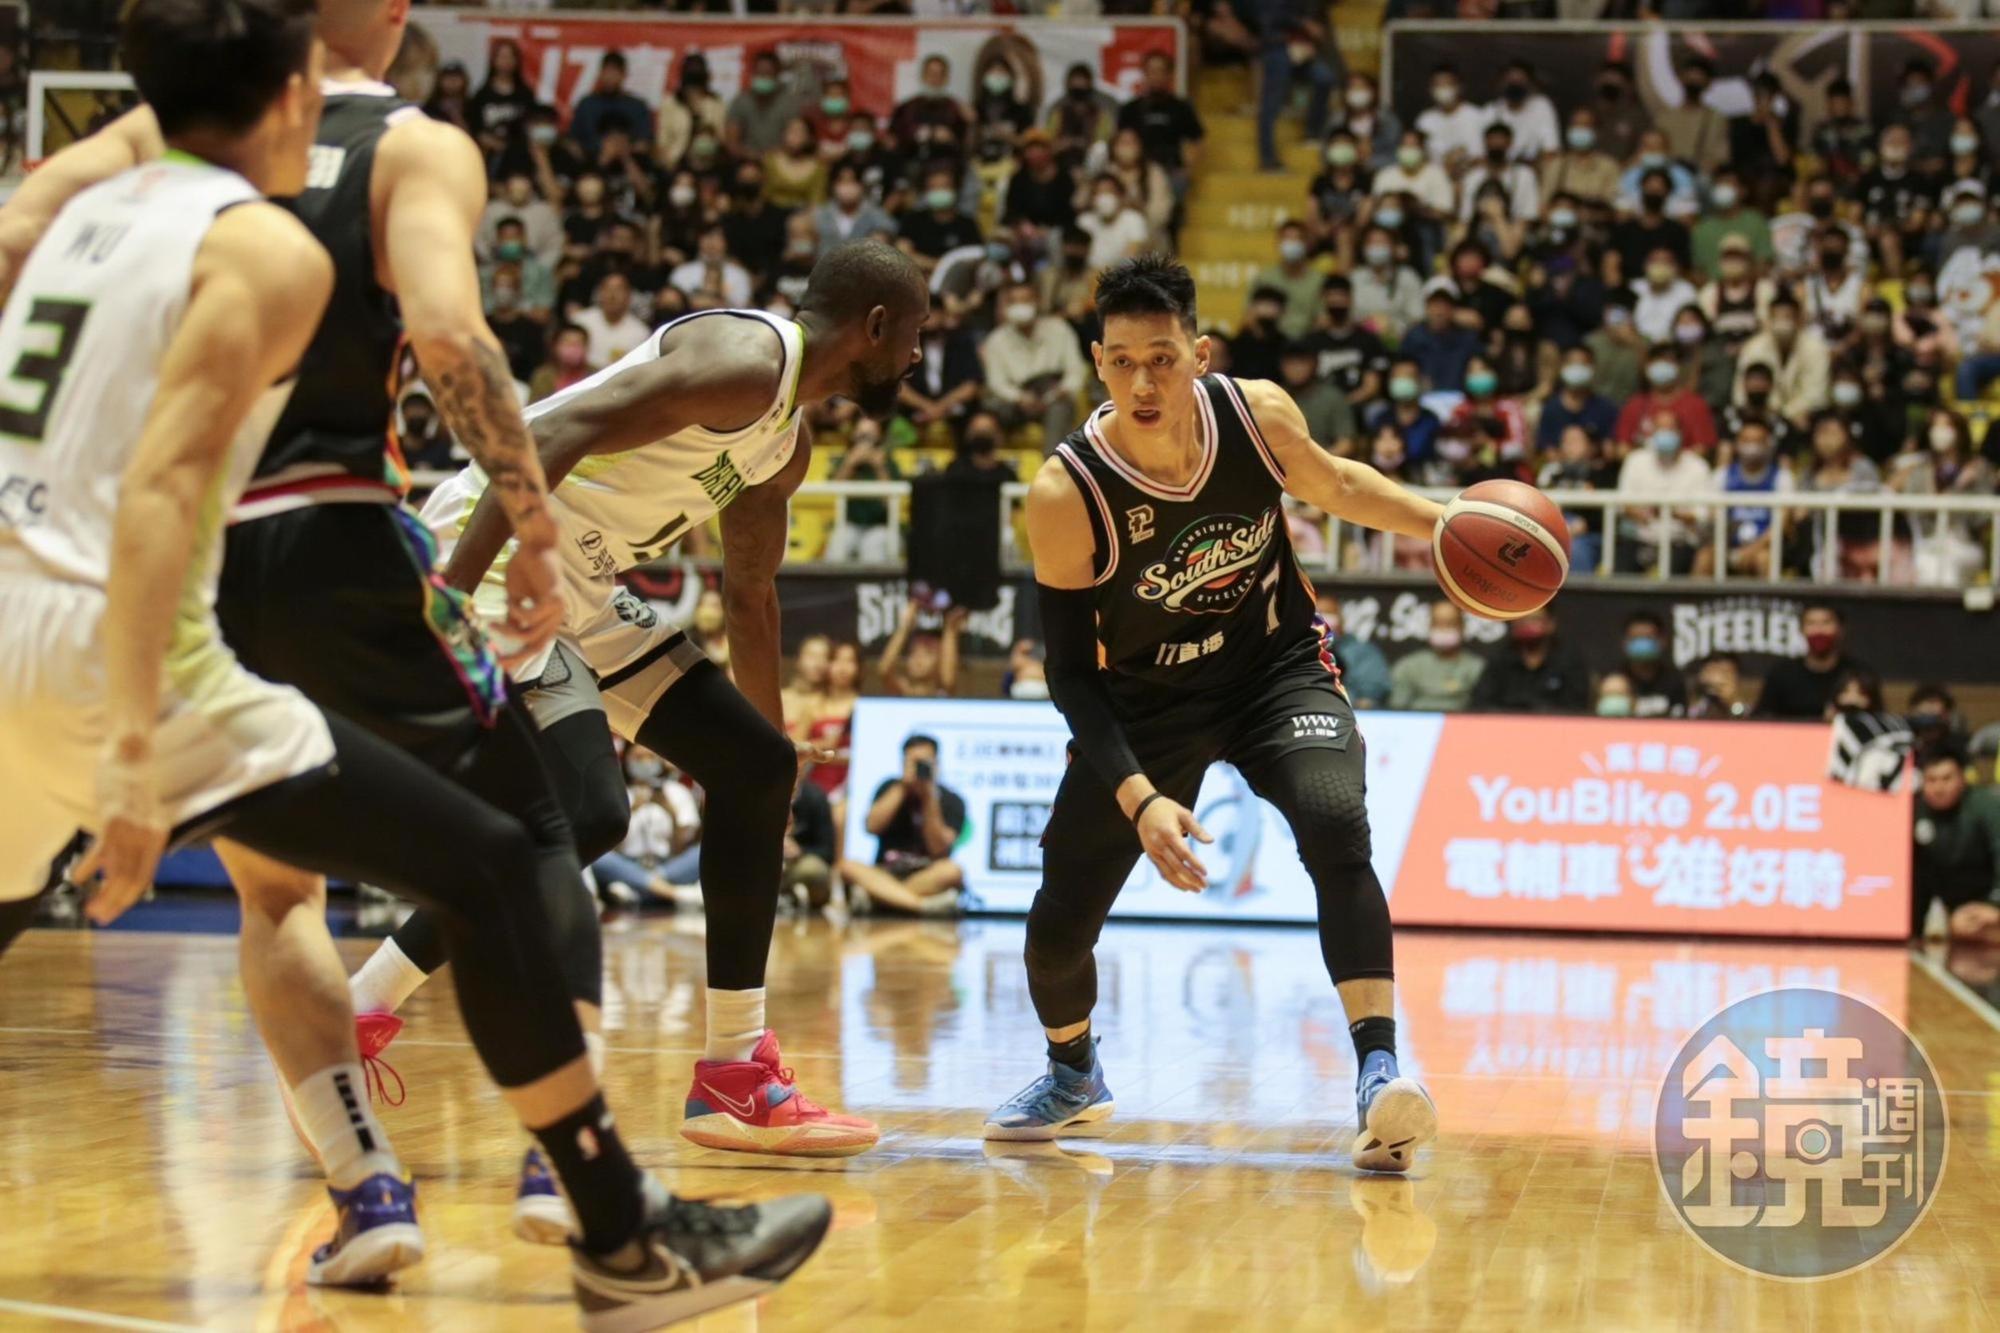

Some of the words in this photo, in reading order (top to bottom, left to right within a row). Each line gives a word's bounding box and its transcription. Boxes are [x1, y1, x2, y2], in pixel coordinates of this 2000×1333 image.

[0, 296, 93, 442] 3
[1173, 522, 1233, 562] KAOHSIUNG
[1261, 560, 1281, 635] 7
[1468, 776, 1691, 828] YouBike
[1705, 783, 1822, 831] 2.0E
